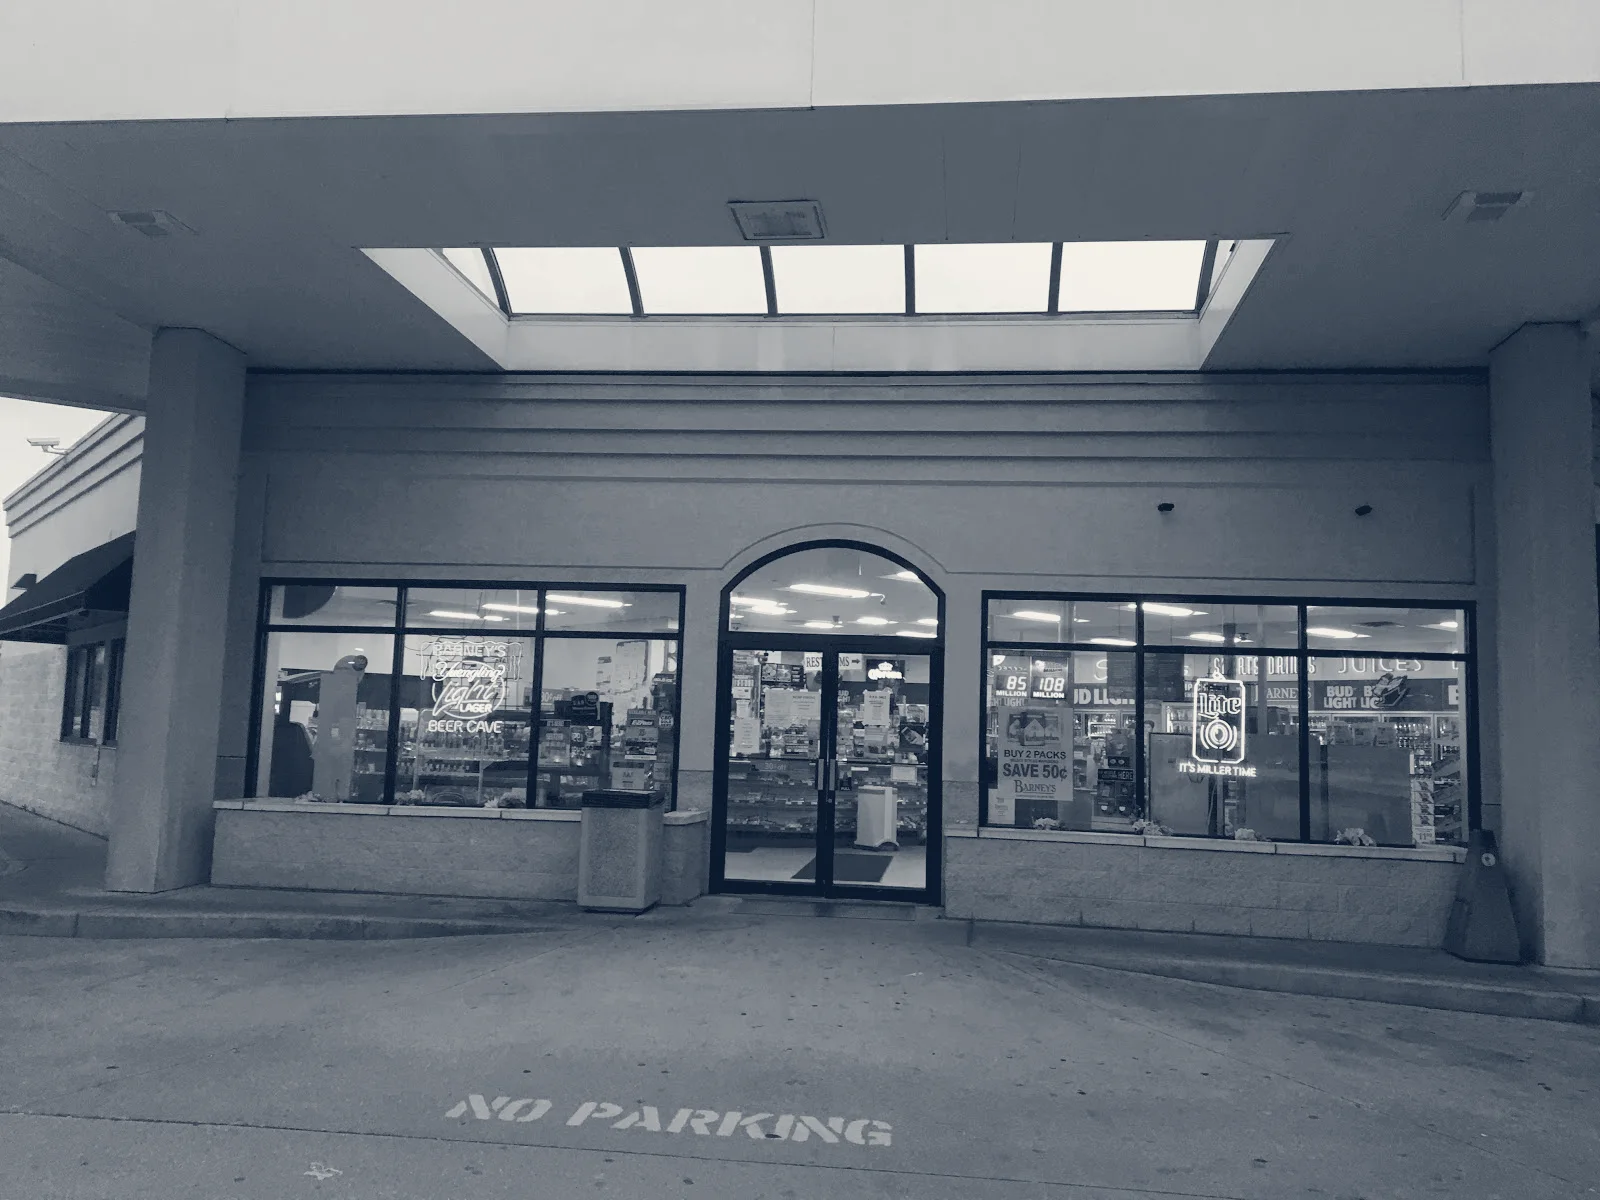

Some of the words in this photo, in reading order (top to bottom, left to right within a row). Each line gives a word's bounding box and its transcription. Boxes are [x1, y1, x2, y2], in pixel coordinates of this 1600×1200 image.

[432, 661, 506, 683] Yuengling
[1006, 675, 1027, 691] 85
[1039, 677, 1065, 692] 108
[432, 680, 499, 716] Light
[1326, 685, 1354, 698] BUD
[460, 702, 493, 713] LAGER
[1198, 692, 1242, 720] Lite
[1323, 697, 1357, 709] LIGHT
[428, 719, 463, 733] BEER
[466, 720, 503, 734] CAVE
[1003, 749, 1024, 758] BUY
[1025, 750, 1032, 759] 2
[1033, 750, 1067, 760] PACKS
[1002, 763, 1040, 778] SAVE
[1042, 764, 1068, 782] 50¢
[1179, 761, 1196, 773] IT'S
[1196, 764, 1232, 776] MILLER
[1233, 765, 1257, 778] TIME
[1014, 779, 1056, 793] BARNEY'S
[444, 1093, 553, 1123] NO
[565, 1100, 893, 1147] PARKING
